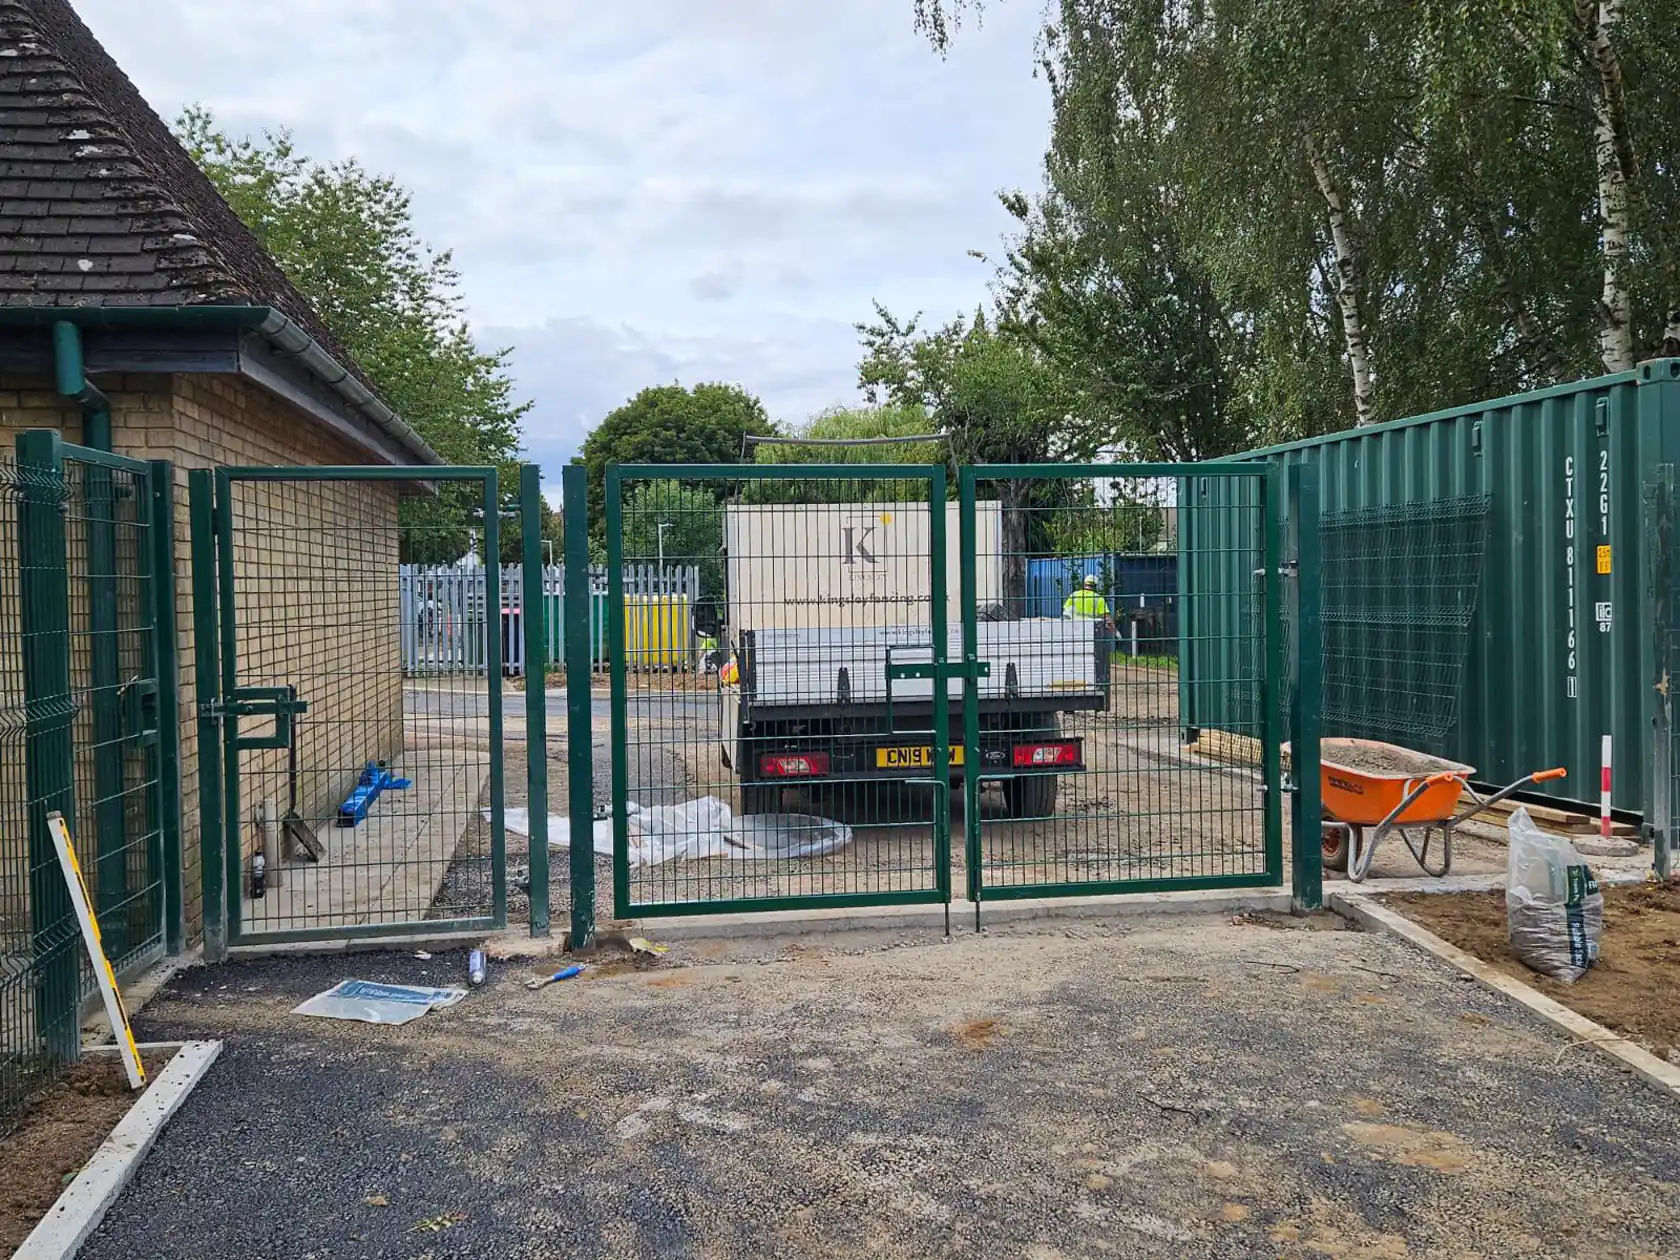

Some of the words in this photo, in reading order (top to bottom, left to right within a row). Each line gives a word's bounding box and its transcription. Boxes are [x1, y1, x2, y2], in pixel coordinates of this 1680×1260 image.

[1565, 456, 1574, 539] CTXU
[1599, 450, 1608, 536] 22G1
[841, 526, 881, 565] K
[1566, 545, 1576, 670] 811166
[1599, 622, 1612, 632] 87
[887, 749, 922, 765] CN19
